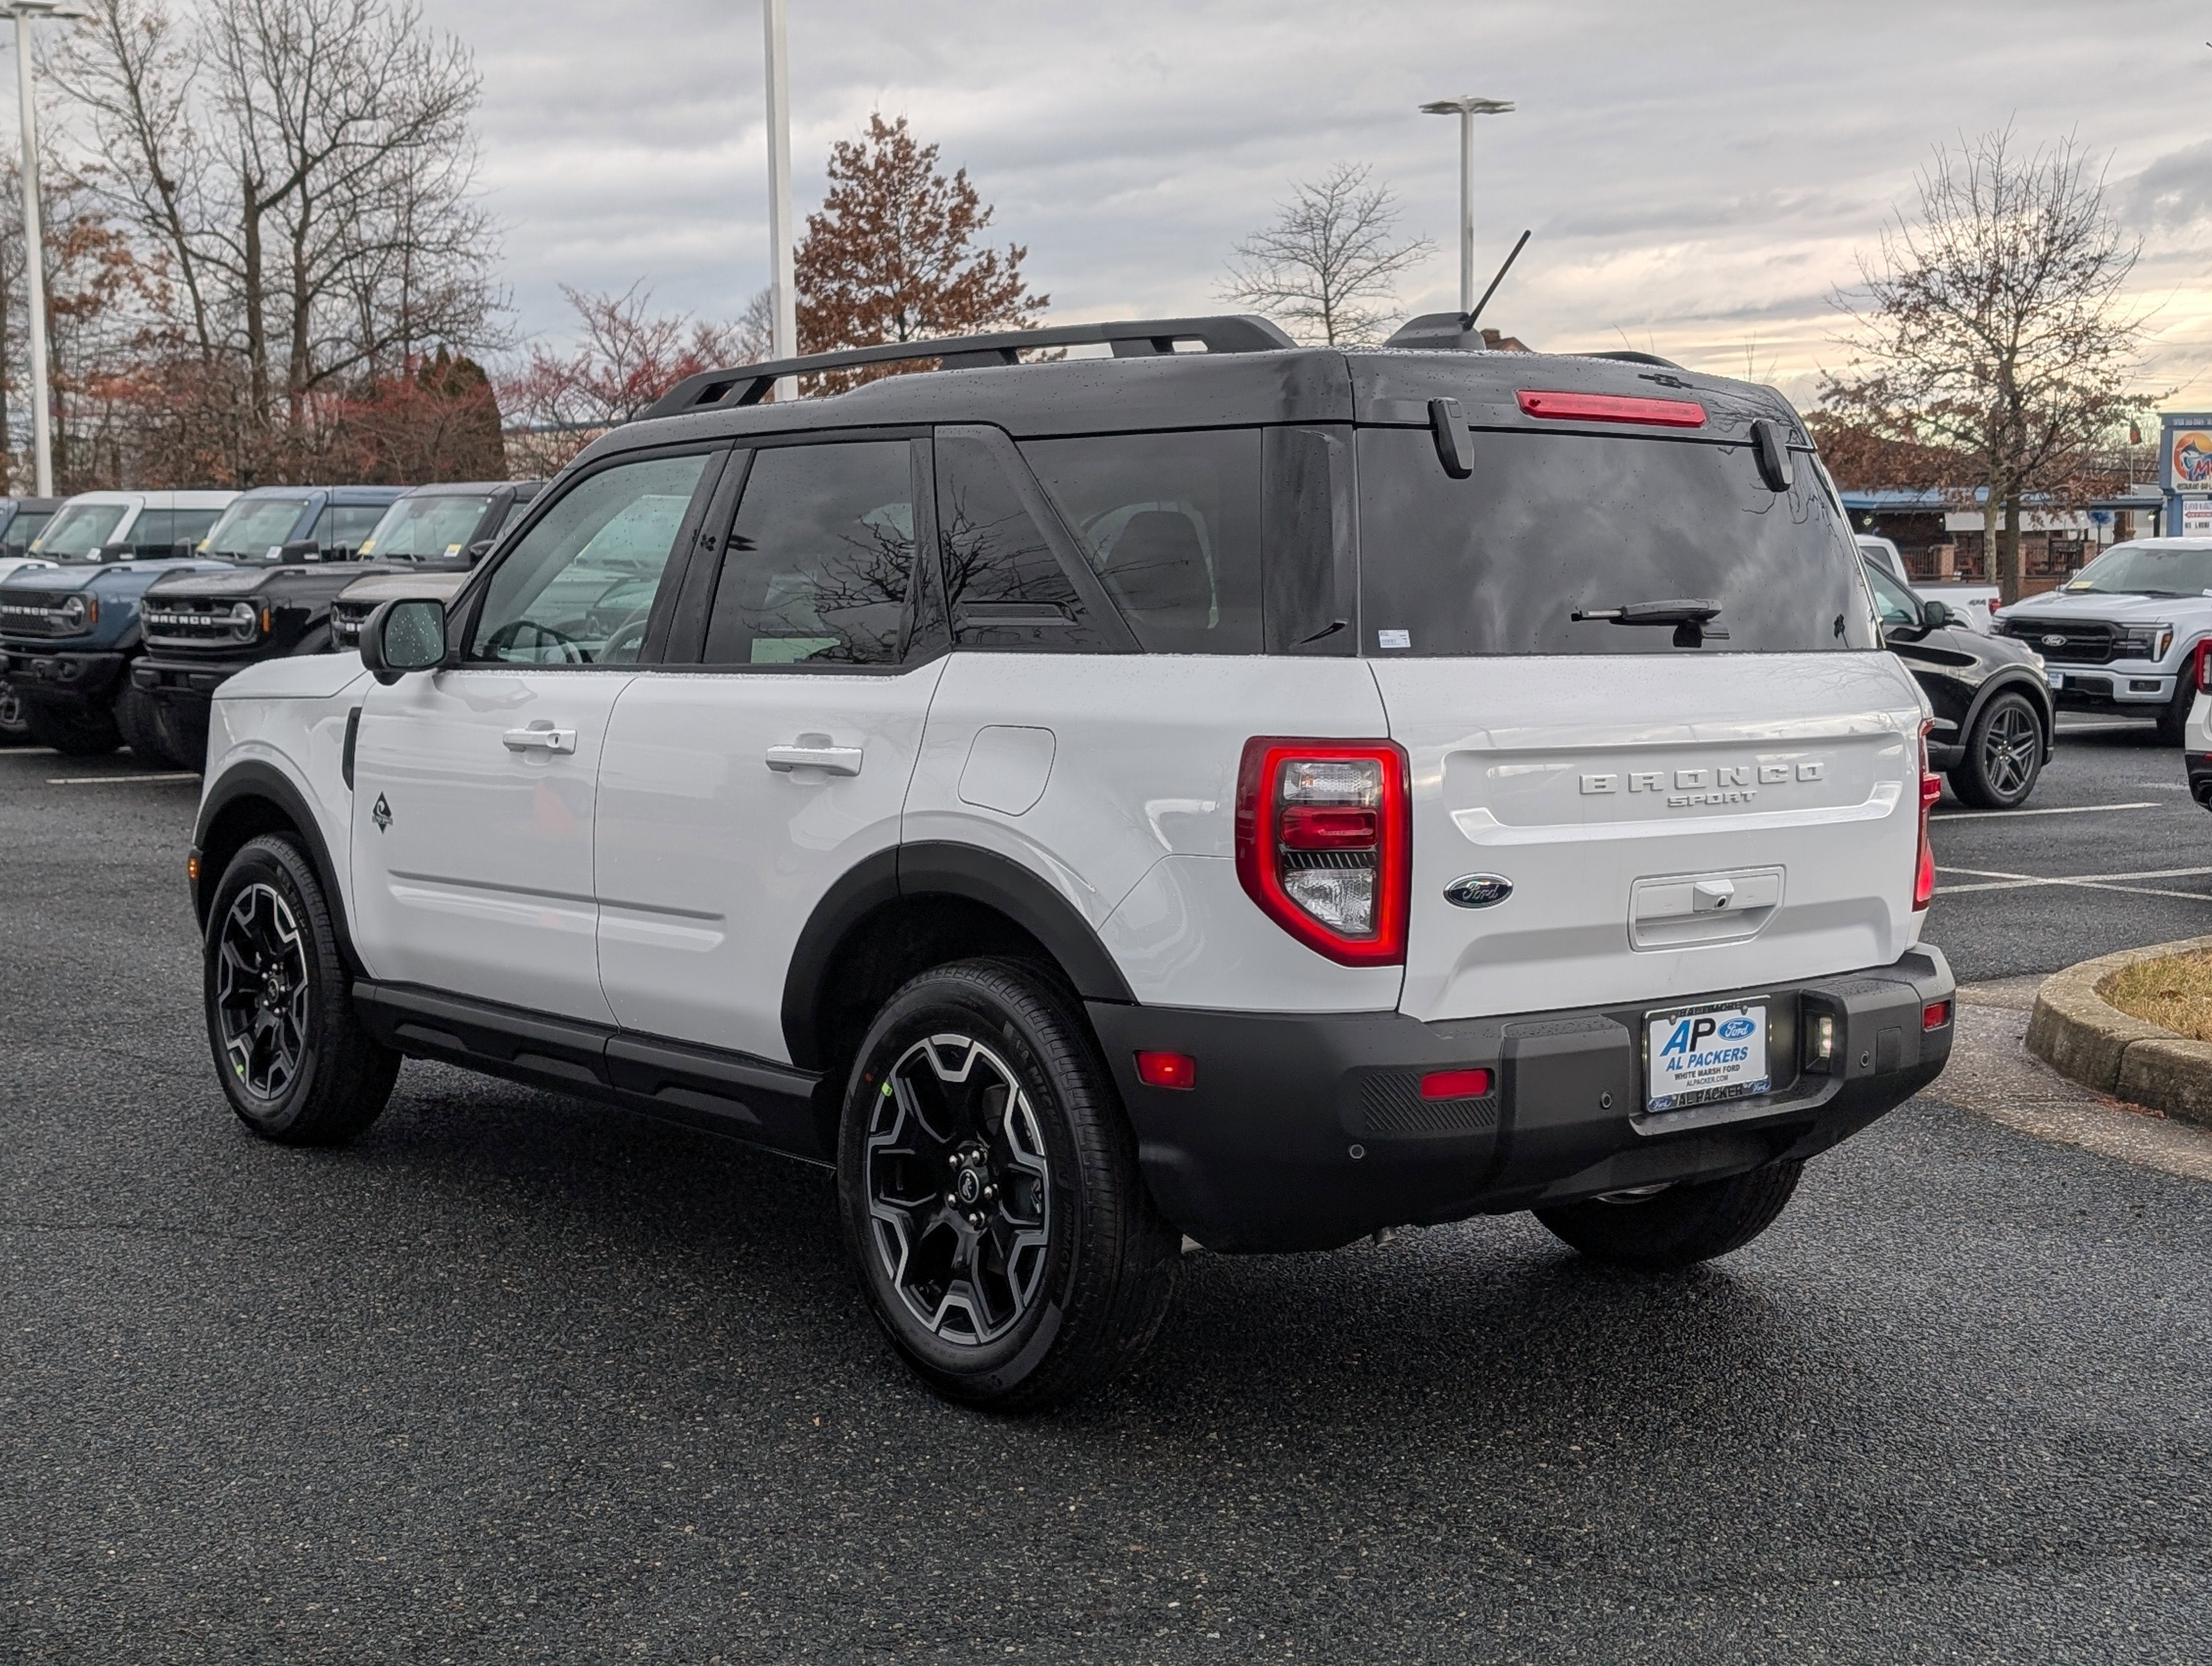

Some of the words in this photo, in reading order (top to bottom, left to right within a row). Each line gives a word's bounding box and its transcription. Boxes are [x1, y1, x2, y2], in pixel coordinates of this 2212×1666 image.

[2194, 459, 2212, 476] M
[1579, 762, 1824, 794] BRONCO
[1667, 790, 1758, 808] SPORT
[1462, 881, 1500, 900] Ford
[1660, 1018, 1716, 1057] AP
[1725, 1021, 1748, 1037] Ford
[1666, 1056, 1683, 1072] AL
[1687, 1047, 1748, 1068] PACKERS
[1675, 1071, 1696, 1080] WHITE
[1697, 1066, 1721, 1077] MARSH
[1723, 1064, 1740, 1073] FORD
[1686, 1074, 1729, 1087] ALPACKER.COM
[1696, 1086, 1742, 1103] PACKER
